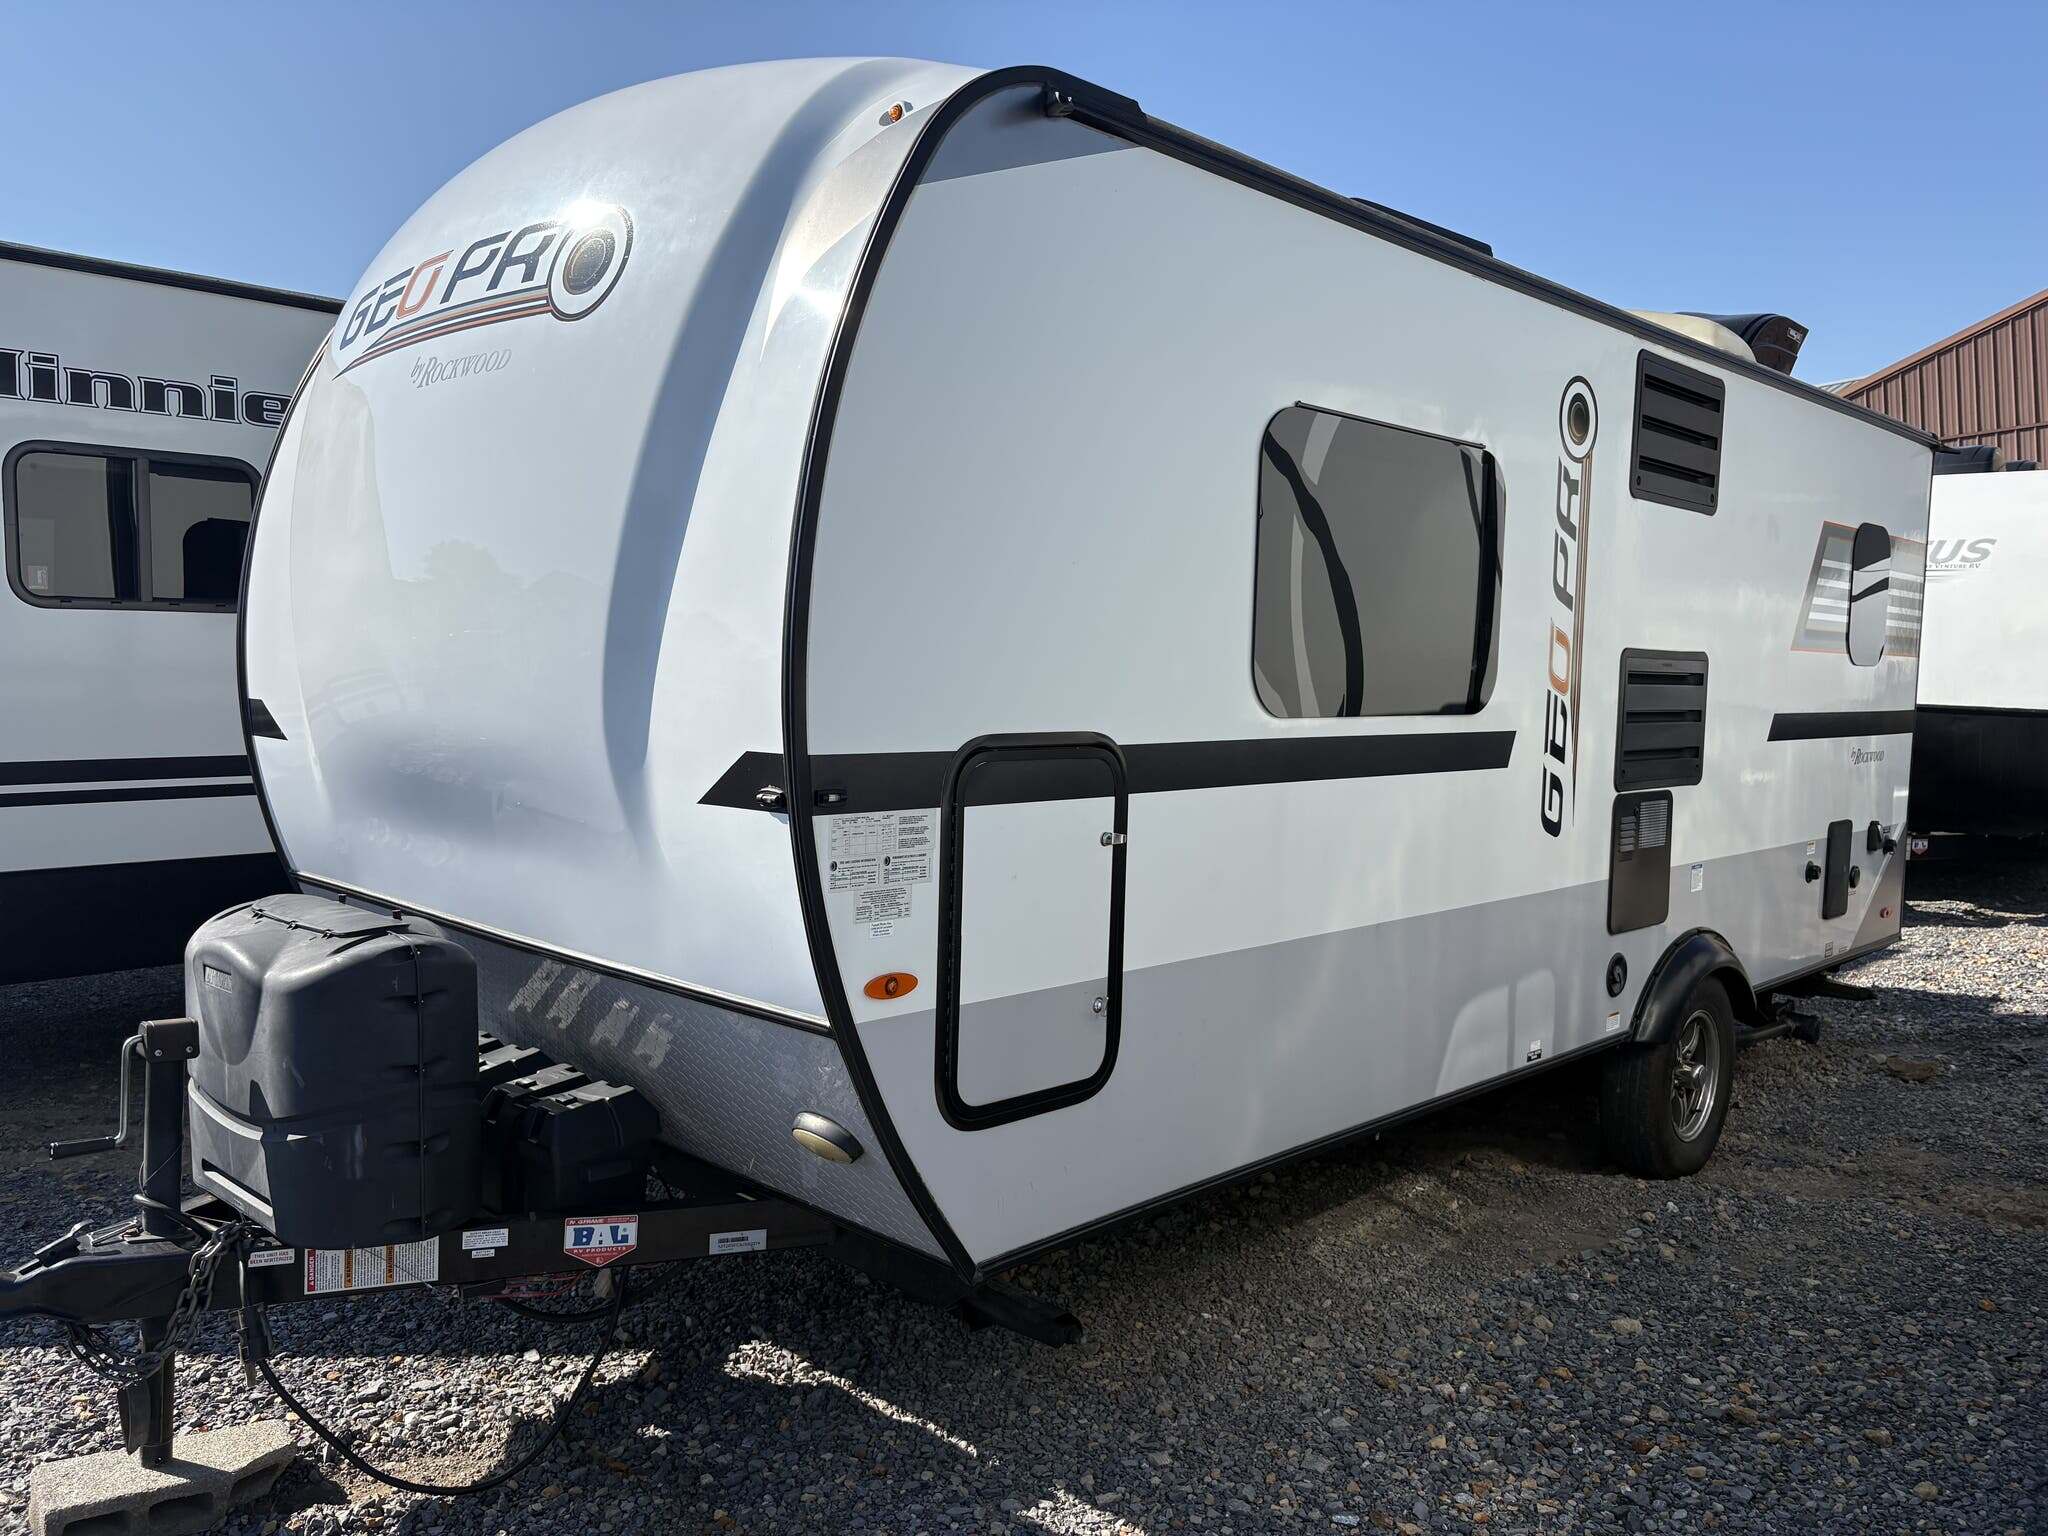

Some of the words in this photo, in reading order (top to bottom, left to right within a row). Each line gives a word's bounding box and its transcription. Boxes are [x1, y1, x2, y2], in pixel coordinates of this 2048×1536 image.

[340, 248, 454, 351] GEO
[0, 347, 294, 429] innie
[1928, 537, 1998, 564] US
[1540, 617, 1572, 838] GEO
[572, 1225, 629, 1246] BAL
